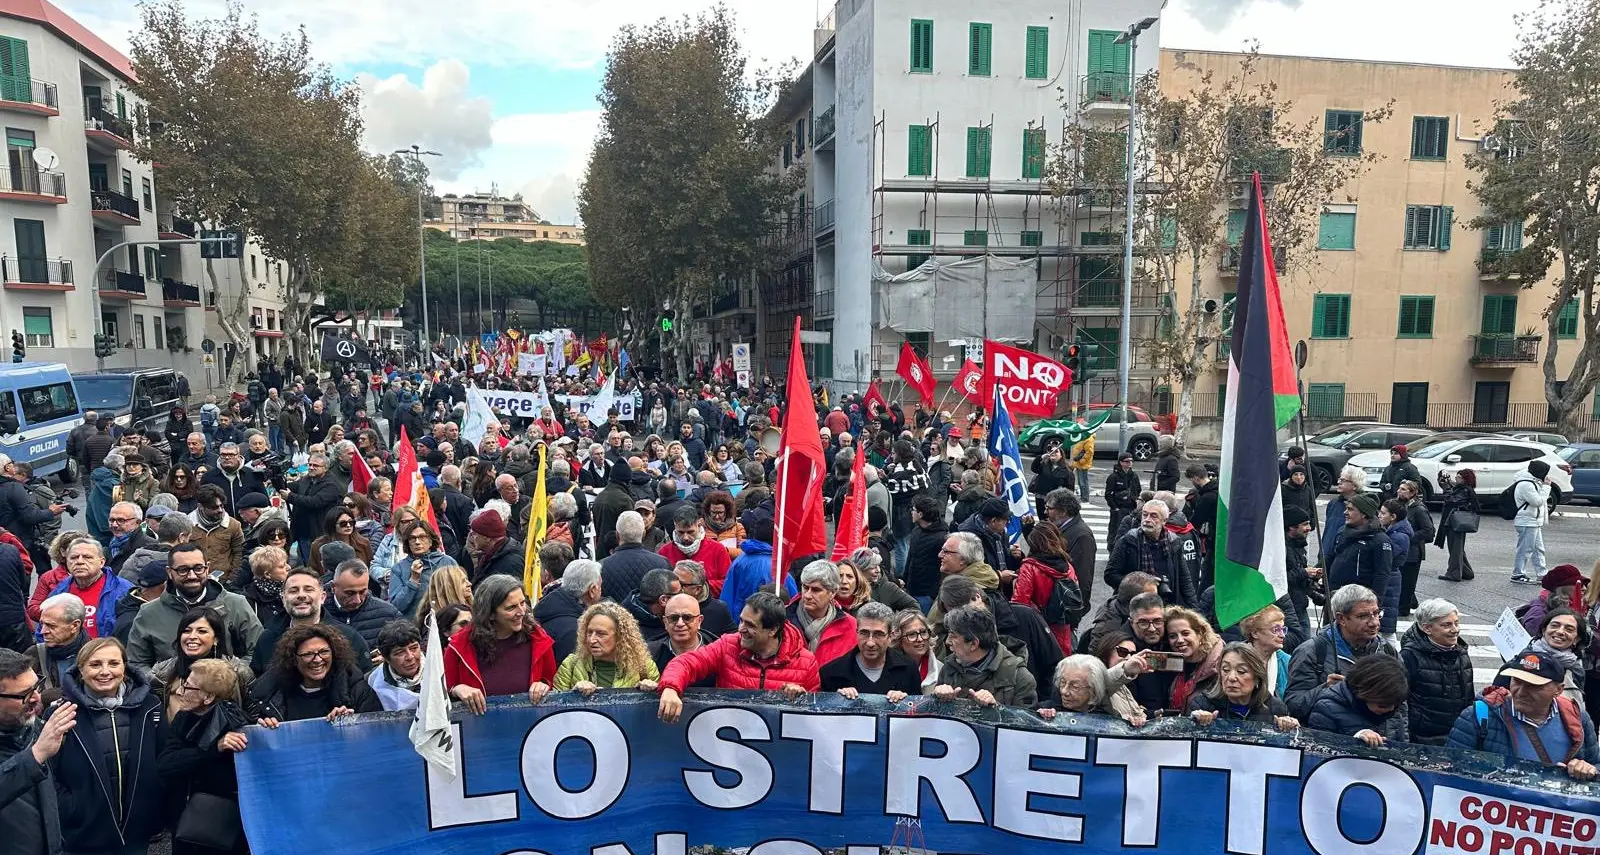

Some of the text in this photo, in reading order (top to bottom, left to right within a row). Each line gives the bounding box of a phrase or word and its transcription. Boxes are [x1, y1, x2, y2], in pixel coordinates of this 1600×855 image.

[484, 396, 532, 412] vece
[992, 383, 1058, 406] PONT
[29, 438, 60, 456] POLIZIA
[424, 707, 632, 831] LO
[682, 706, 1428, 855] STRETTO
[1460, 796, 1597, 842] CORTEO
[1430, 819, 1484, 852] NO
